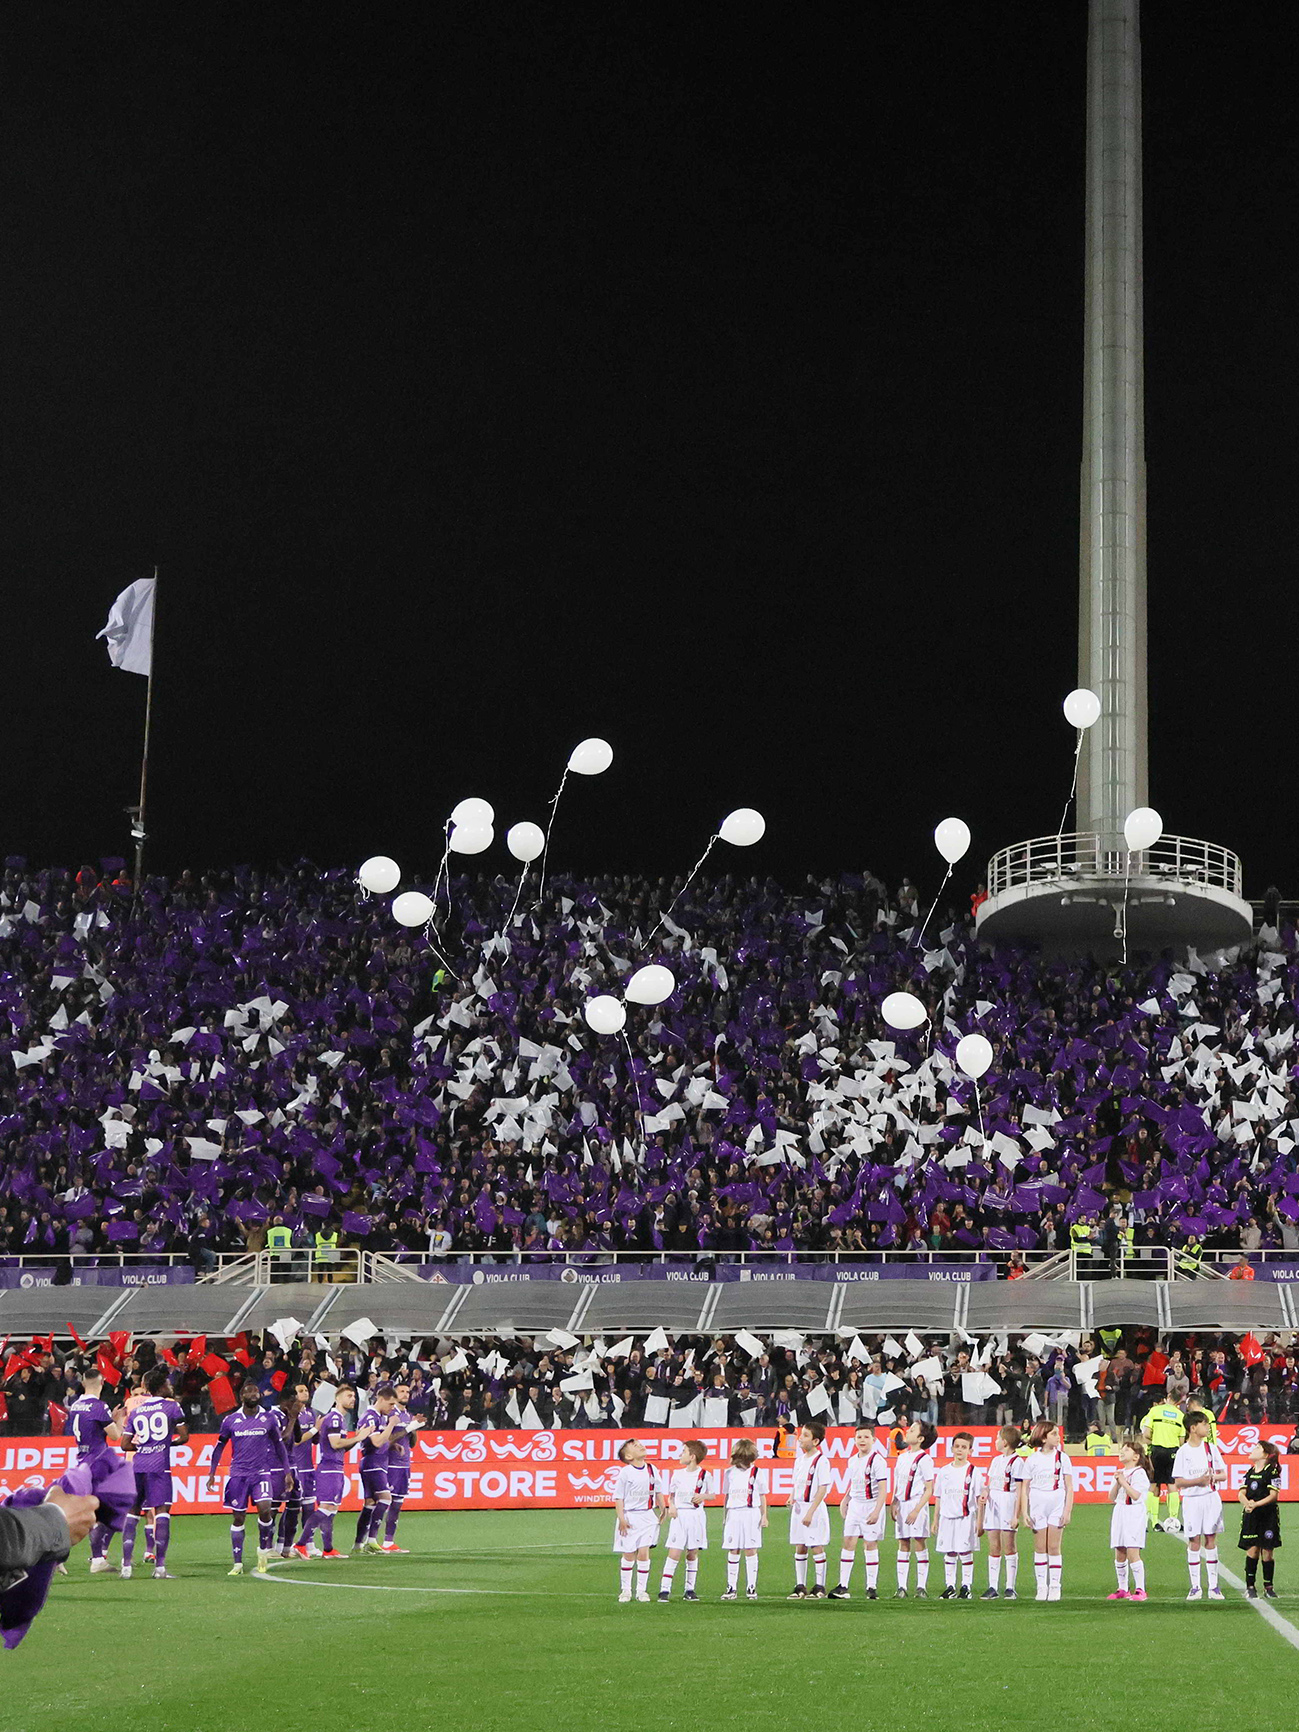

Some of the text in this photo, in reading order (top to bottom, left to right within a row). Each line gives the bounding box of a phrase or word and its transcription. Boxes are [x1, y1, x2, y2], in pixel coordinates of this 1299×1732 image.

[147, 1275, 168, 1284] CLUB
[578, 1273, 621, 1283] VIOLA CLUB
[666, 1271, 709, 1281] VIOLA CLUB
[836, 1271, 879, 1281] VIOLA CLUB
[928, 1272, 971, 1281] VIOLA CLUB
[1272, 1270, 1294, 1279] VIOLA
[72, 1414, 81, 1442] 4
[133, 1412, 169, 1444] 99
[234, 1429, 265, 1437] Mediacom
[260, 1481, 270, 1493] 11
[434, 1470, 558, 1499] STORE
